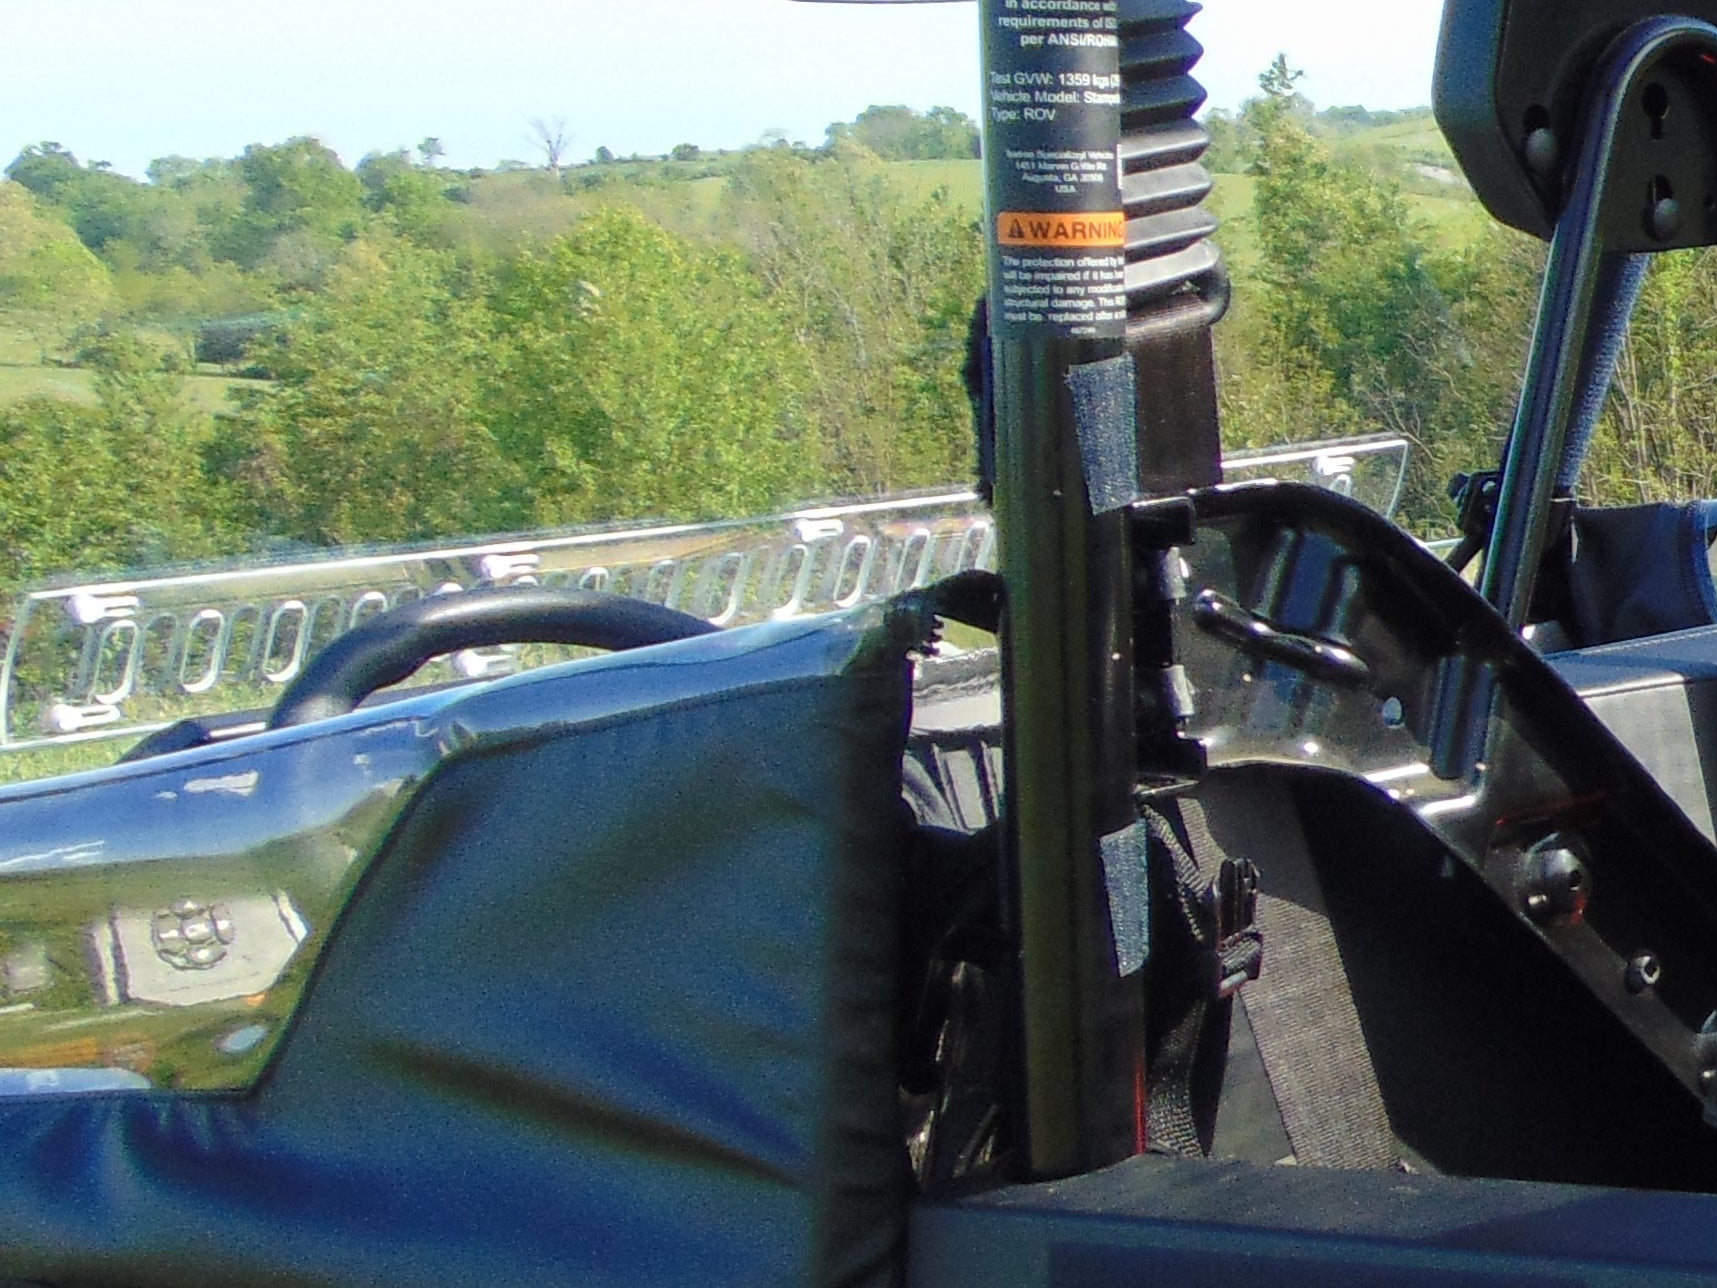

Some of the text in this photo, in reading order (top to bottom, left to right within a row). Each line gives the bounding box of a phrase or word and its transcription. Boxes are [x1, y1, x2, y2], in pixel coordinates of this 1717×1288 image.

[1021, 0, 1100, 11] accordance
[998, 15, 1089, 28] requirements
[1093, 18, 1103, 28] of
[1020, 35, 1044, 47] per
[990, 72, 1011, 85] Test
[1014, 73, 1053, 85] GVW:
[1059, 74, 1090, 86] 1359
[1092, 74, 1109, 89] kgs
[991, 91, 1031, 103] Vehicle
[1035, 91, 1080, 103] Model:
[991, 107, 1056, 121] Type: ROV
[1022, 257, 1075, 268] protection
